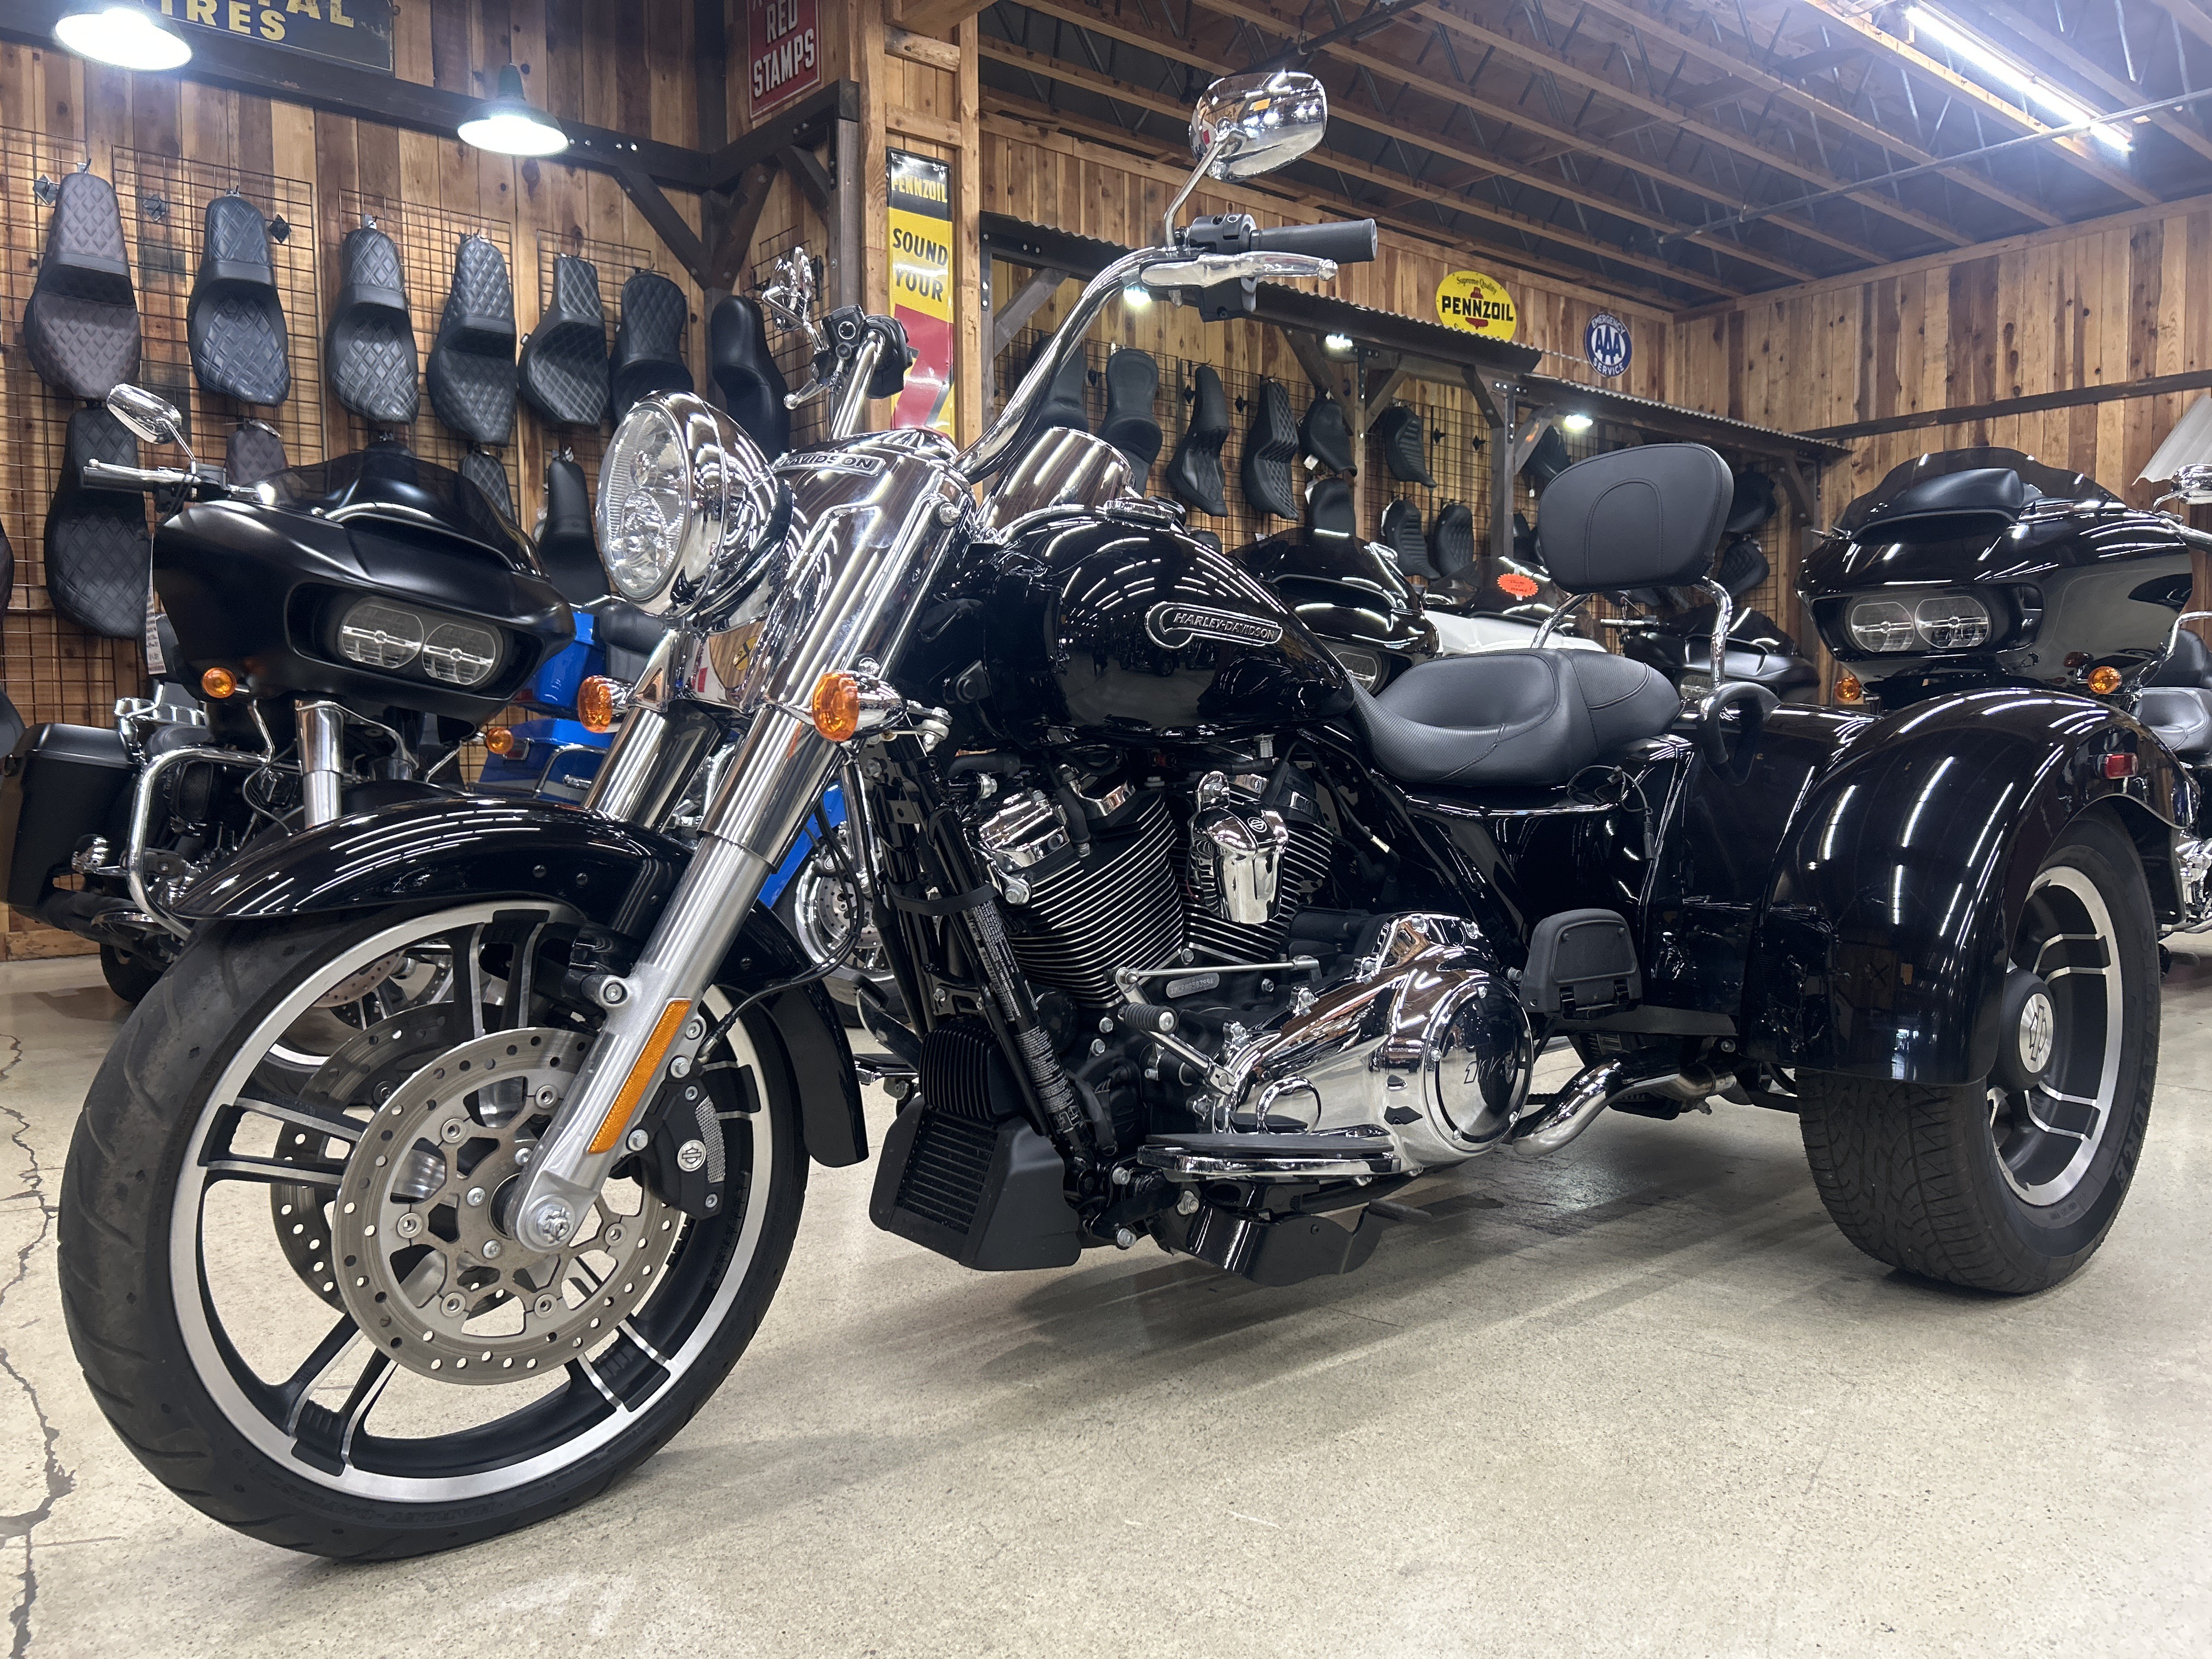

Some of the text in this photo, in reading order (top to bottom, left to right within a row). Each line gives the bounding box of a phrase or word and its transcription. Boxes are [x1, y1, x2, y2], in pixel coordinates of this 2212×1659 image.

[258, 0, 353, 27] AL
[766, 0, 798, 43] RED
[754, 28, 815, 98] STAMPS
[891, 174, 948, 204] PENNZOIL
[892, 228, 948, 266] SOUND
[895, 268, 943, 302] YOUR
[1441, 295, 1514, 322] PENNZOIL
[1591, 314, 1626, 335] EMERGENCY
[1595, 325, 1622, 364] AAA
[1593, 357, 1624, 376] SERVICE
[1173, 612, 1275, 640] HARLEY-DAVIDSON
